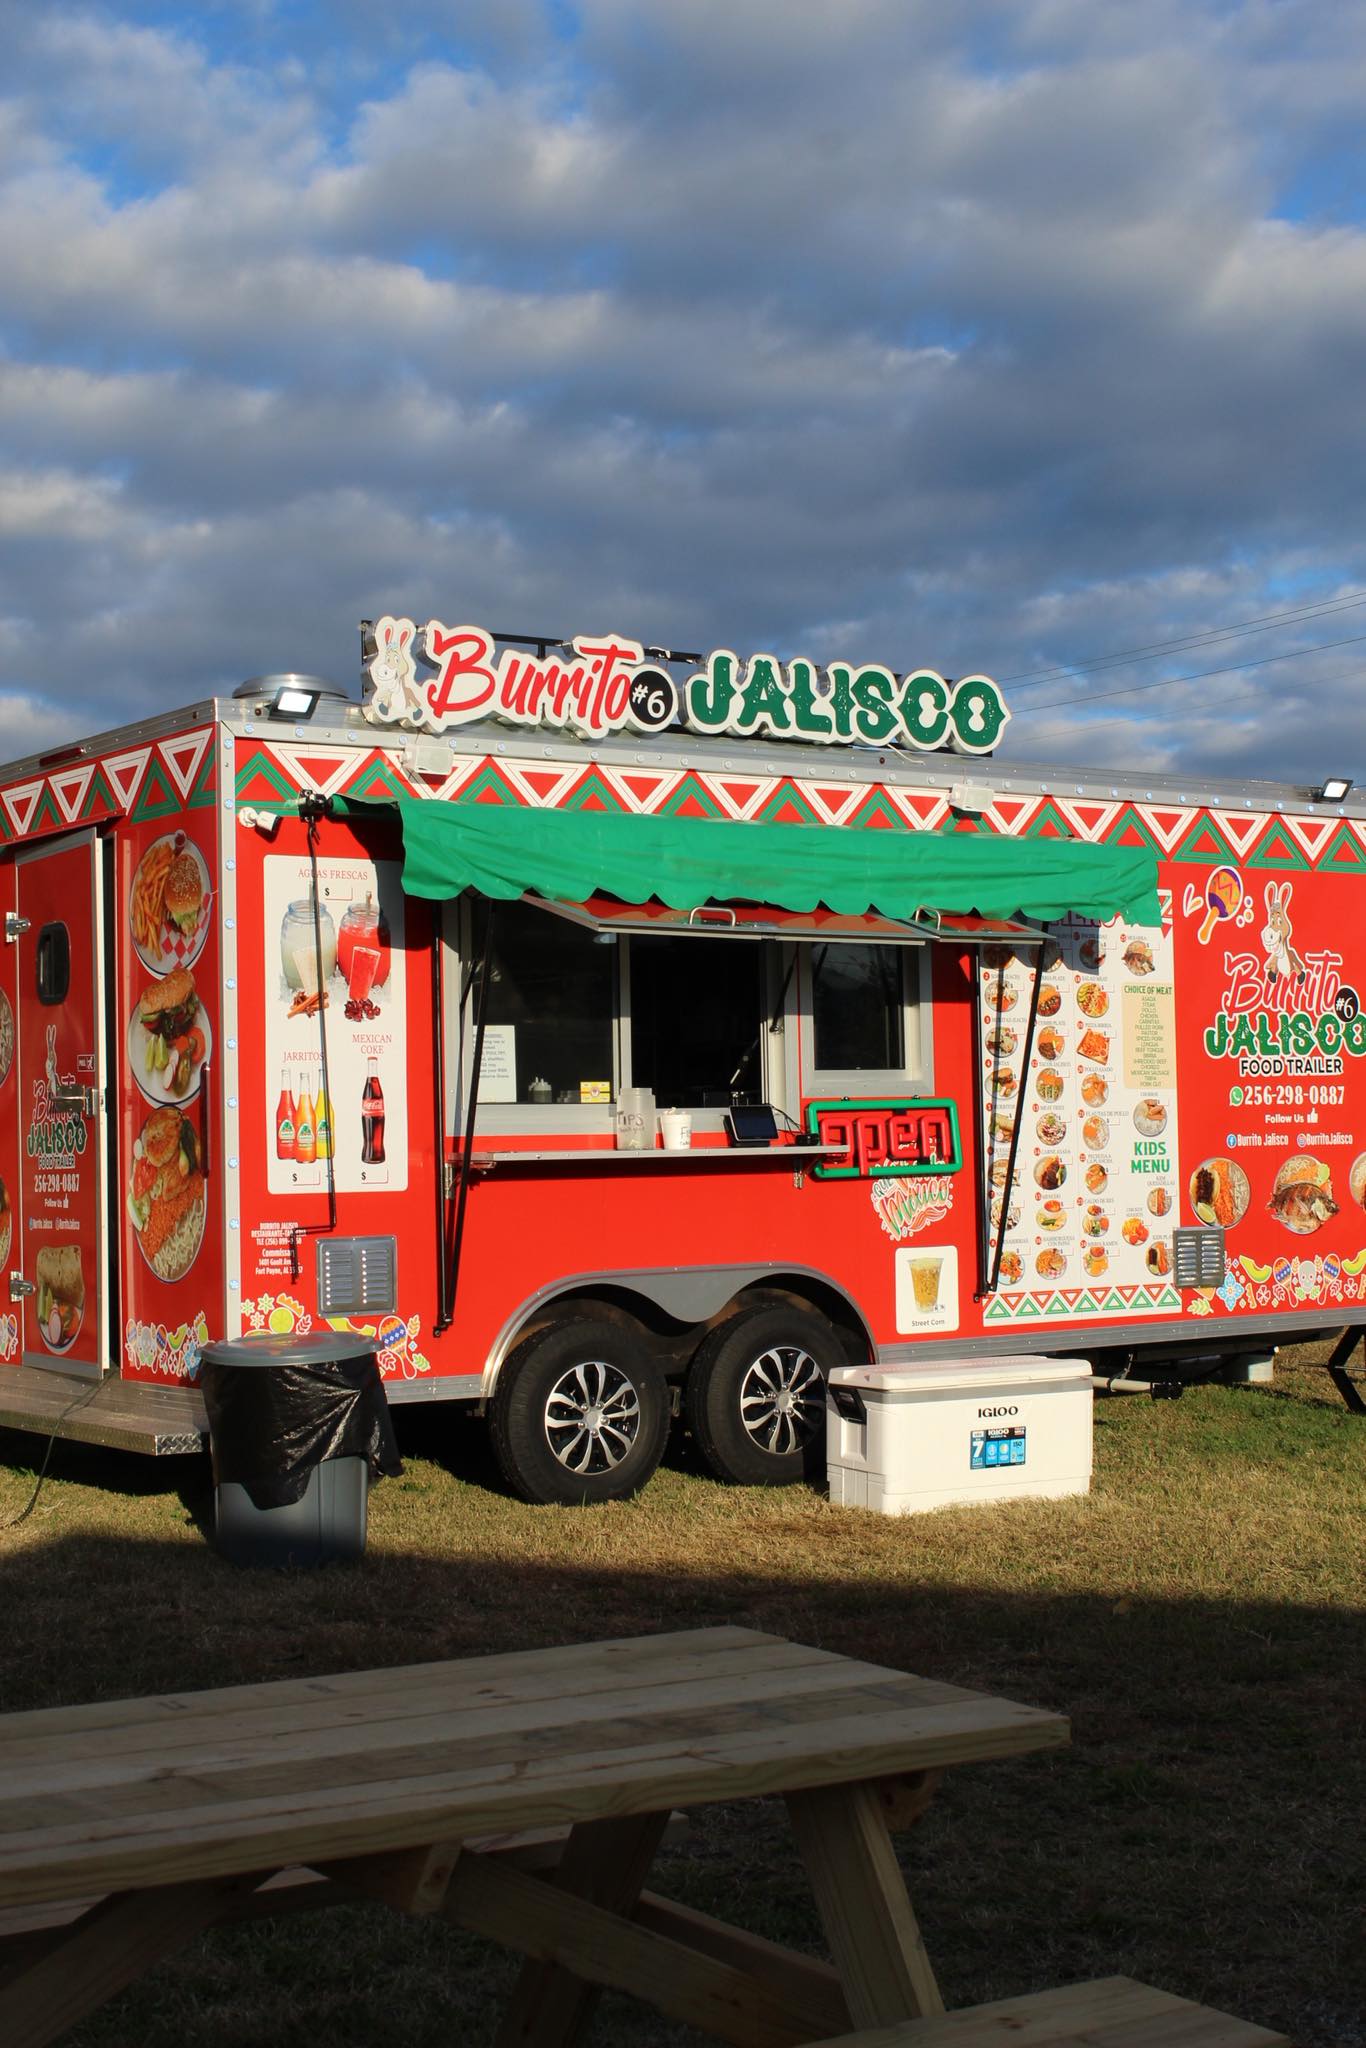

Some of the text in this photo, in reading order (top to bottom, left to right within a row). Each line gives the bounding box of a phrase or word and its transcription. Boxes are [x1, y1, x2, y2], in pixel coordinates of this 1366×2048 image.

[428, 627, 666, 731] Burrito #6
[690, 649, 1005, 749] JALISCO
[298, 868, 369, 881] AGAS FRESCAS
[1124, 985, 1172, 995] CHOICE OF MEAT
[1221, 949, 1354, 1021] Burrito #6
[352, 1033, 393, 1045] MEXICAN
[1204, 1011, 1366, 1058] JALISCO
[360, 1044, 385, 1056] COKE
[1240, 1058, 1343, 1075] FOOD TRAILER
[1244, 1085, 1345, 1105] 256-298-0887
[617, 1110, 644, 1126] TIPS
[1265, 1114, 1304, 1123] Follow Us
[27, 1120, 88, 1158] JALISCO
[1237, 1133, 1289, 1147] Burrito Jalisco
[1134, 1142, 1166, 1156] KIDS
[38, 1154, 76, 1169] FOOD TRAILER
[1131, 1159, 1170, 1173] MENU
[34, 1174, 80, 1193] 256-298-0887
[256, 1267, 265, 1275] Fort
[911, 1319, 930, 1327] Street
[977, 1405, 1019, 1418] IGLOO
[988, 1427, 1009, 1436] IGLOO
[972, 1440, 985, 1458] 7
